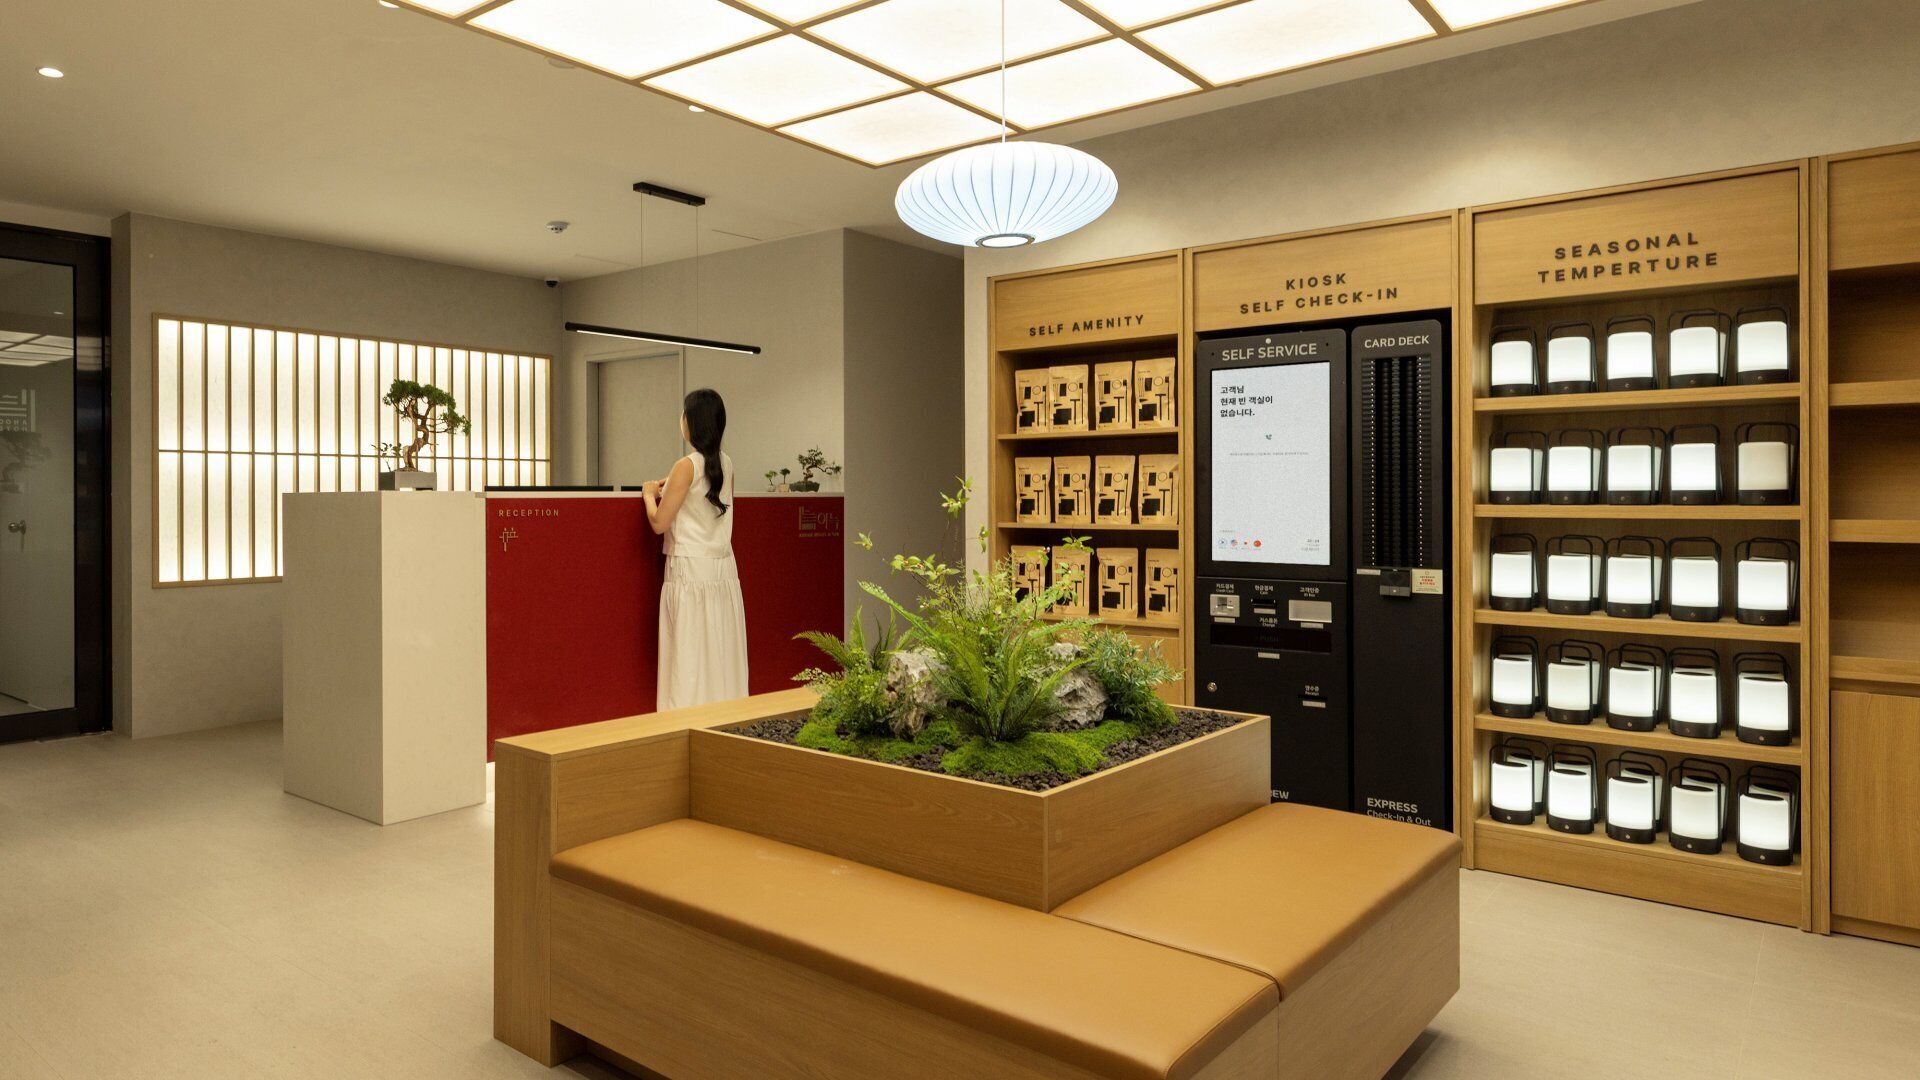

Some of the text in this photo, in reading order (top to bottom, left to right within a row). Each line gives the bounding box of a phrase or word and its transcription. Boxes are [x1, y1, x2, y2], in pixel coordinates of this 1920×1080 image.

[1554, 231, 1700, 260] SEASONAL
[1537, 251, 1719, 284] TEMPERTURE
[1285, 272, 1347, 291] KIOSK
[1239, 287, 1398, 315] SELF CHECK-IN
[1029, 313, 1146, 338] SELF AMENITY
[1364, 335, 1430, 349] CARD DECK
[1221, 343, 1318, 362] SELF SERVICE
[1220, 385, 1245, 395] 고객님
[1220, 395, 1274, 406] 현재 빈 객실이
[1220, 408, 1256, 418] 없습니다.
[498, 509, 559, 517] RECEPTION
[1271, 789, 1290, 800] EW
[1366, 797, 1418, 813] EXPRESS
[1415, 817, 1432, 827] Out
